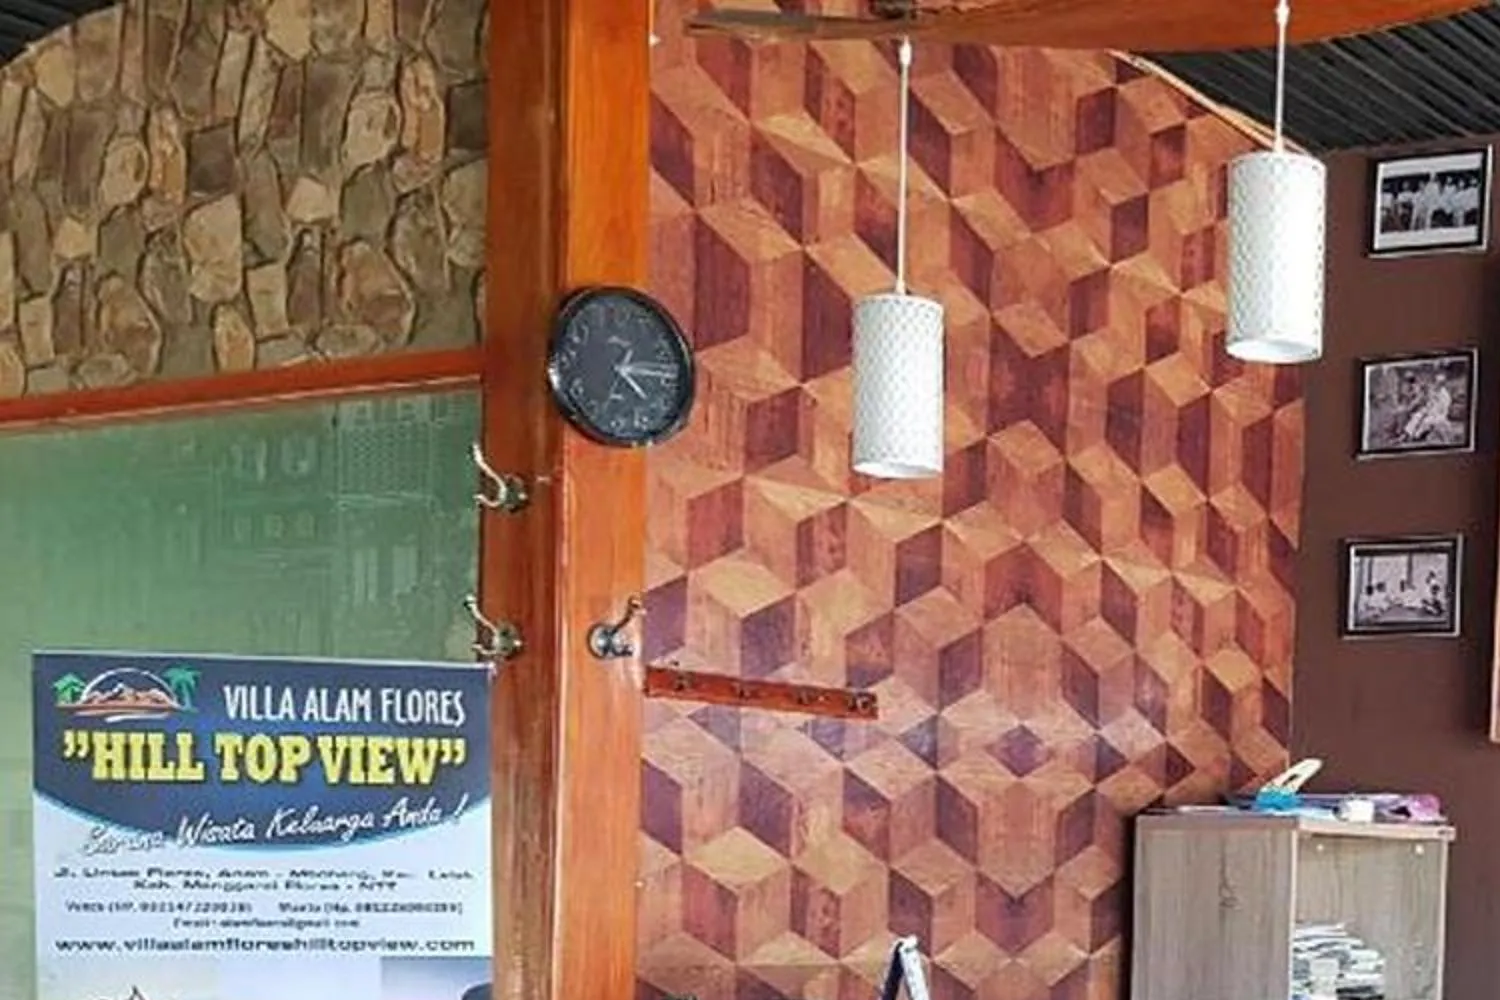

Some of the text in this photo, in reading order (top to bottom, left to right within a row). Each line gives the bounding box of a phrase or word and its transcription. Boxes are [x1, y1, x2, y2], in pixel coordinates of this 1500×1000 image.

[223, 684, 465, 727] VILLA ALAM FLORES
[214, 733, 311, 784] TOP
[176, 811, 255, 848] Wisata
[265, 804, 375, 843] Keluarga
[381, 796, 442, 830] Anda
